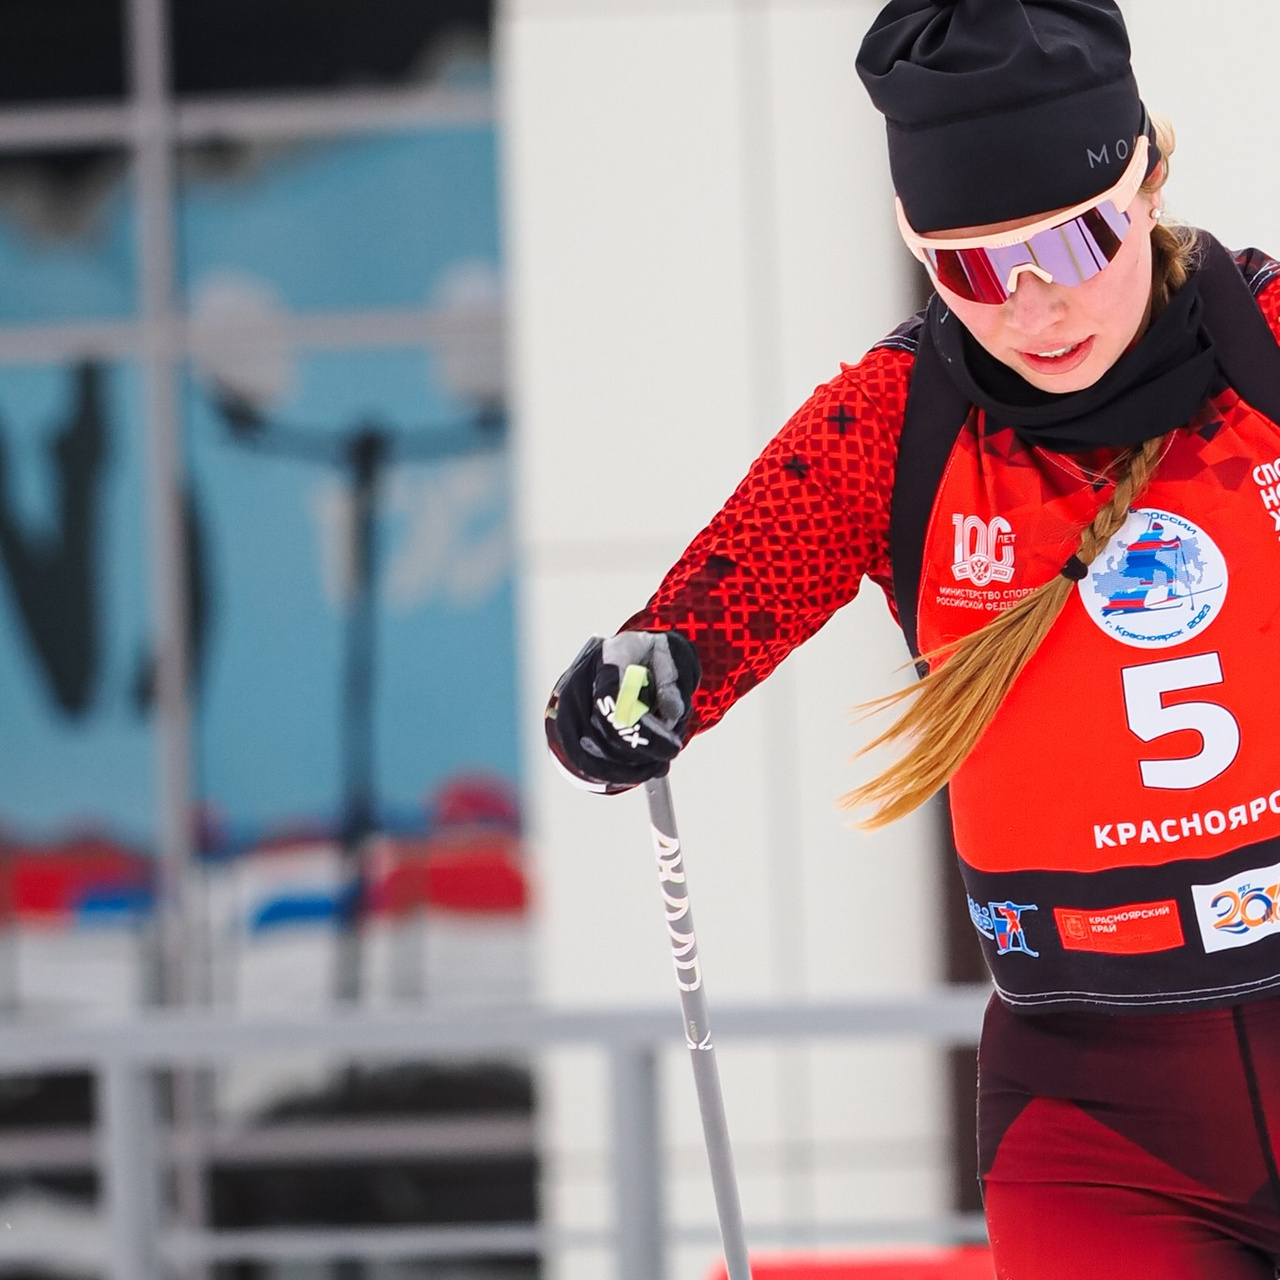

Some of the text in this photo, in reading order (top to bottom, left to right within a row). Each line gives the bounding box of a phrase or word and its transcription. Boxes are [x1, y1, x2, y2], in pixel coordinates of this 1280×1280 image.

[1086, 135, 1137, 169] MO
[997, 534, 1017, 543] ЛЕТ
[939, 587, 1001, 599] МИНИСТЕРСТВО
[985, 601, 1020, 611] ФЕДЕР
[1186, 604, 1211, 630] 2023
[1121, 651, 1241, 790] 5
[1088, 906, 1170, 925] КРАСНОЯРСКИЙ
[1091, 923, 1117, 934] КРАЙ
